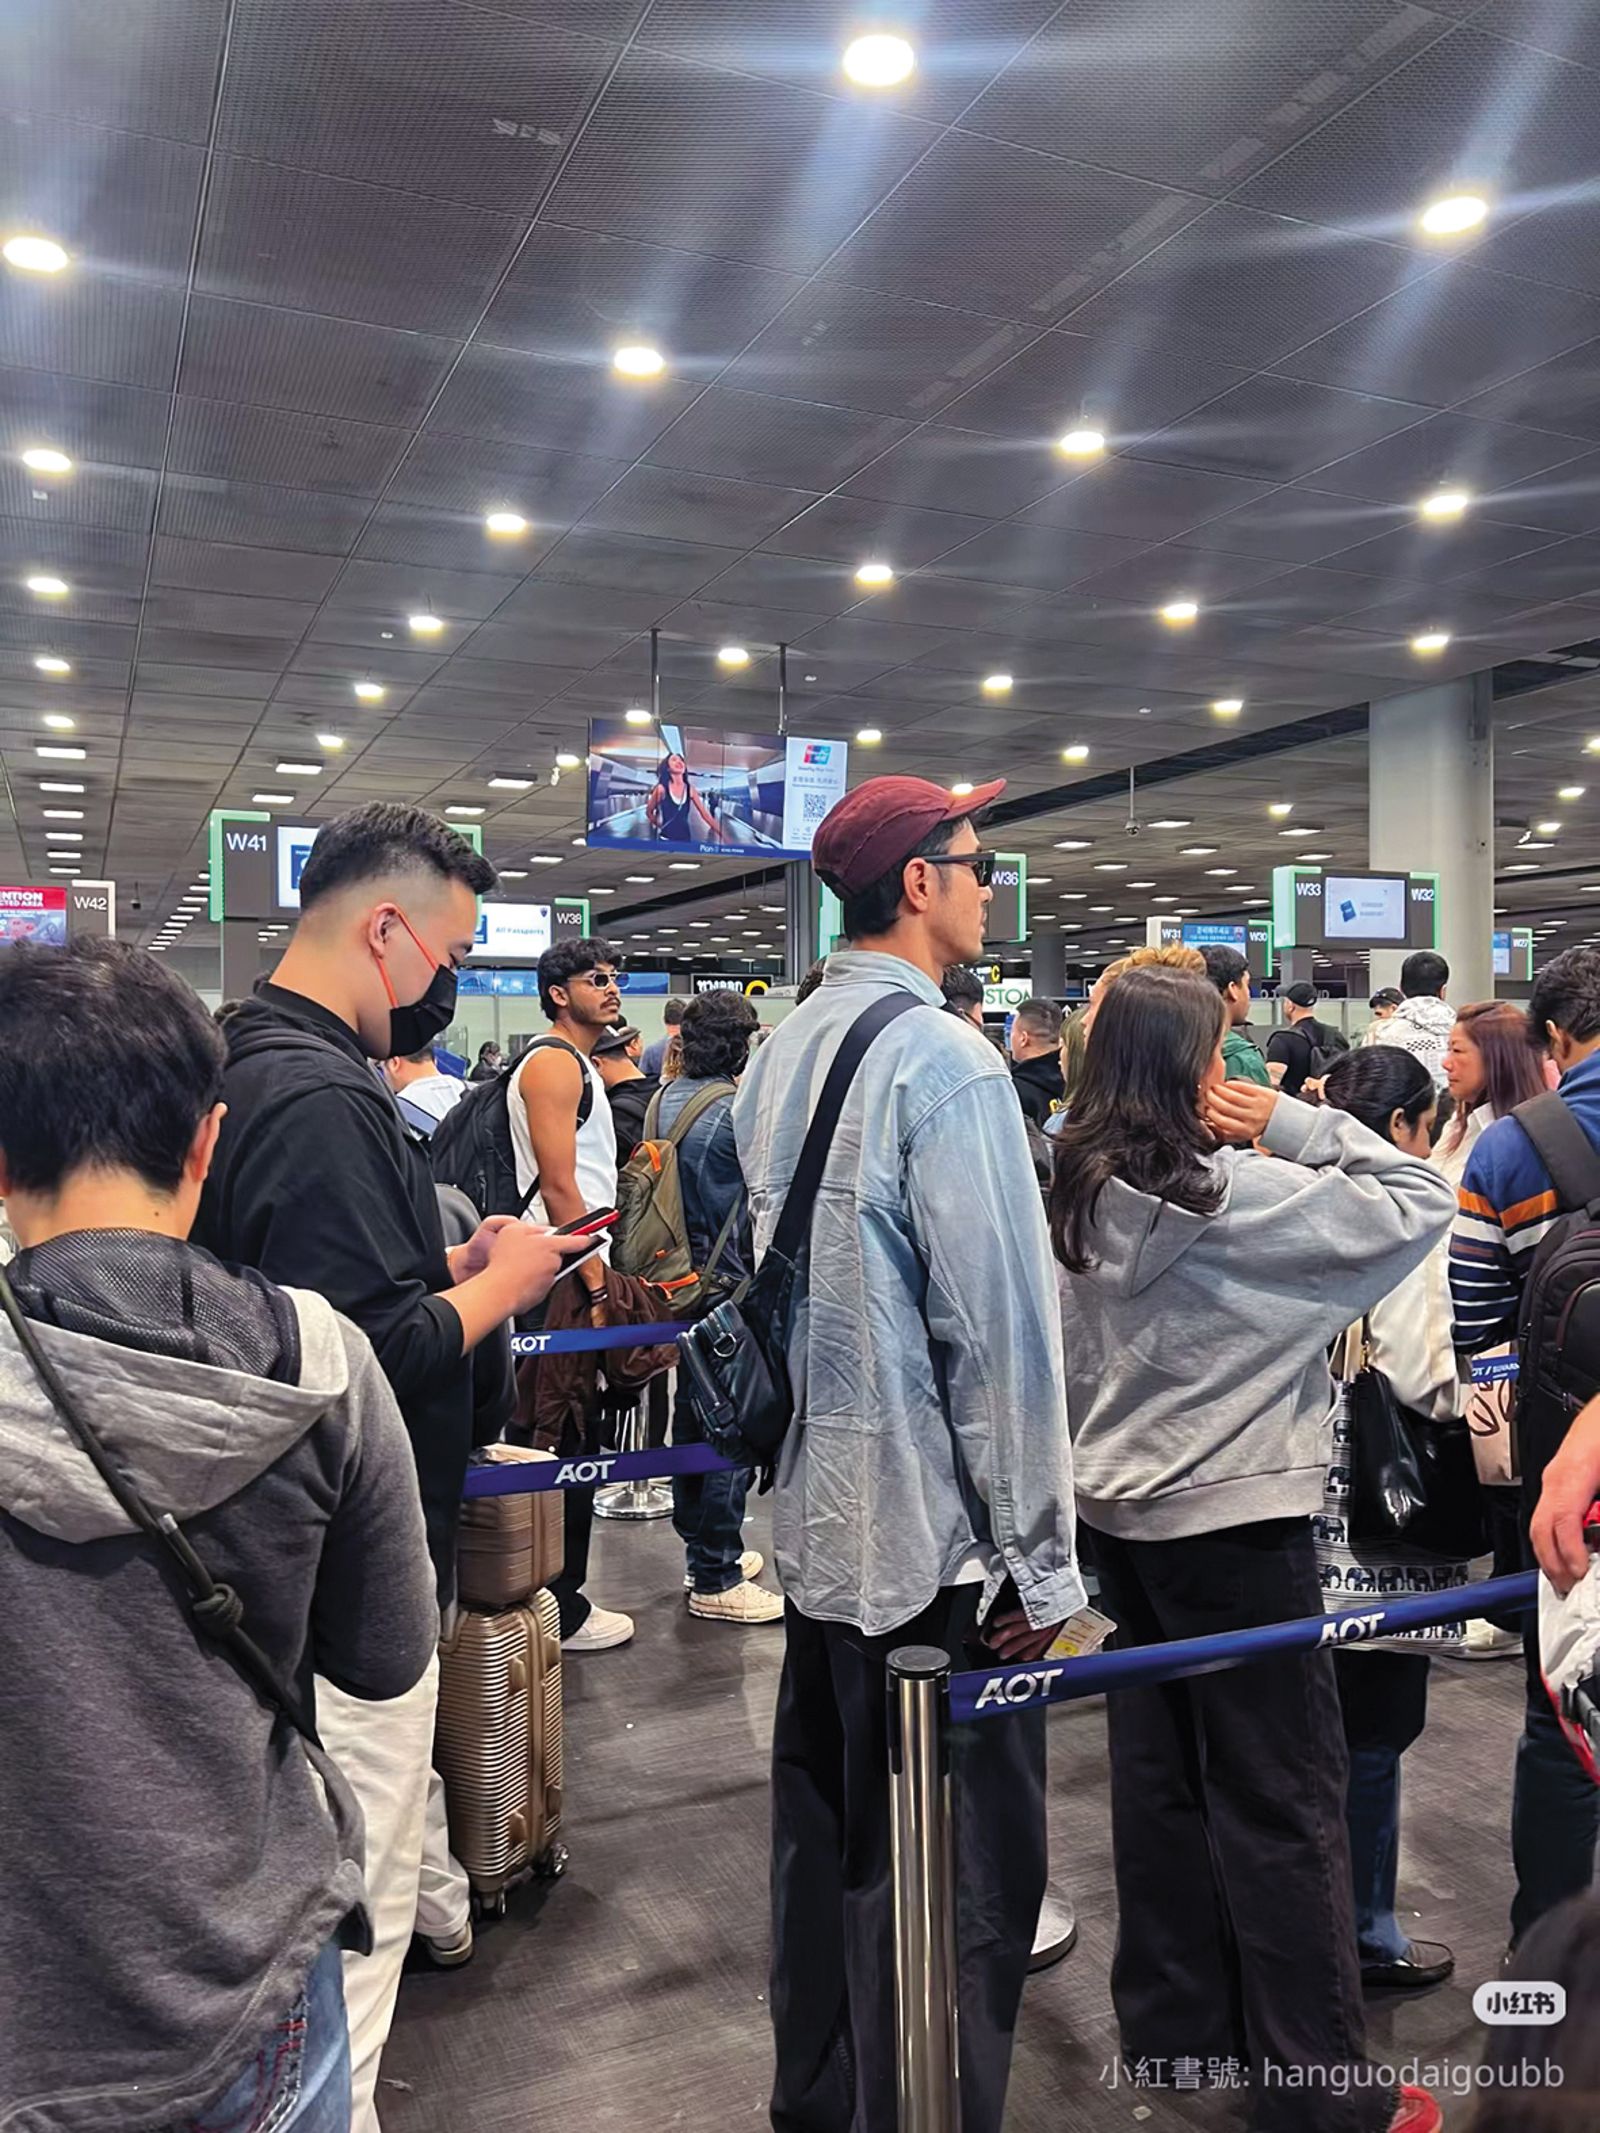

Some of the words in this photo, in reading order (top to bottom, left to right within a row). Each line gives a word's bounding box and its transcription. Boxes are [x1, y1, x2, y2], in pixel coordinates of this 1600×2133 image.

[225, 832, 267, 852] W41
[992, 871, 1019, 885] W36
[1296, 882, 1321, 896] W33
[1411, 887, 1434, 902] W32
[73, 896, 108, 911] W42
[556, 912, 582, 925] W38
[1161, 927, 1181, 939] W31
[1249, 931, 1268, 942] W30
[991, 964, 1001, 983] C
[511, 1334, 552, 1353] AOT
[553, 1459, 617, 1485] AOT
[1313, 1611, 1386, 1650] AOT
[974, 1667, 1064, 1710] AOT
